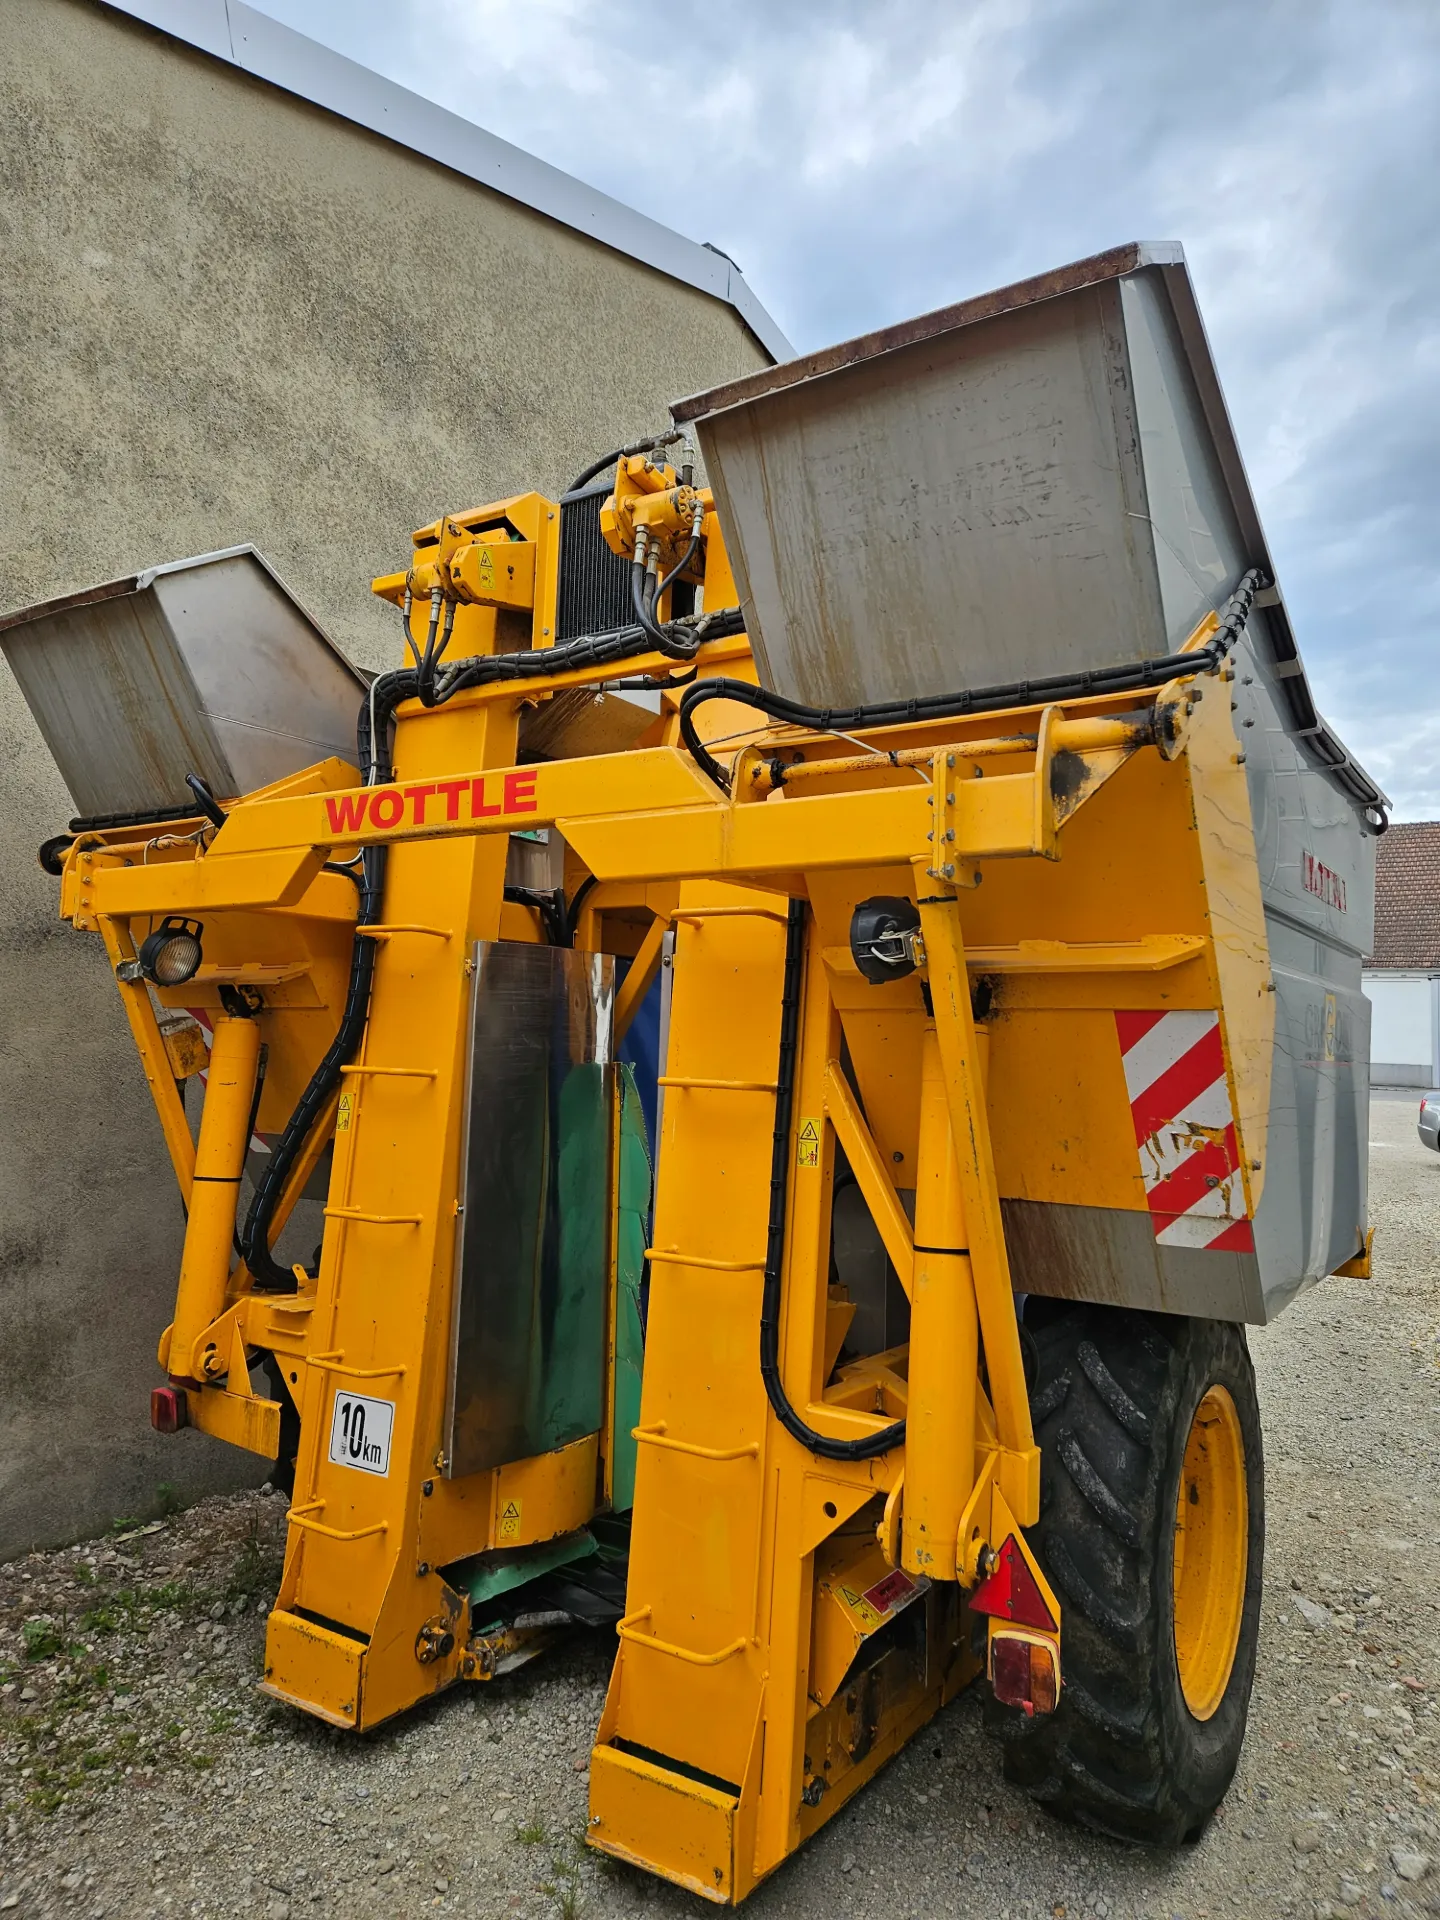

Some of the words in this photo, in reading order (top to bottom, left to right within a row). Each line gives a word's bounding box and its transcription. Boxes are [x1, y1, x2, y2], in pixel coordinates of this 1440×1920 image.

[325, 770, 538, 834] WOTTLE
[341, 1401, 366, 1459] 10
[362, 1436, 382, 1465] km
